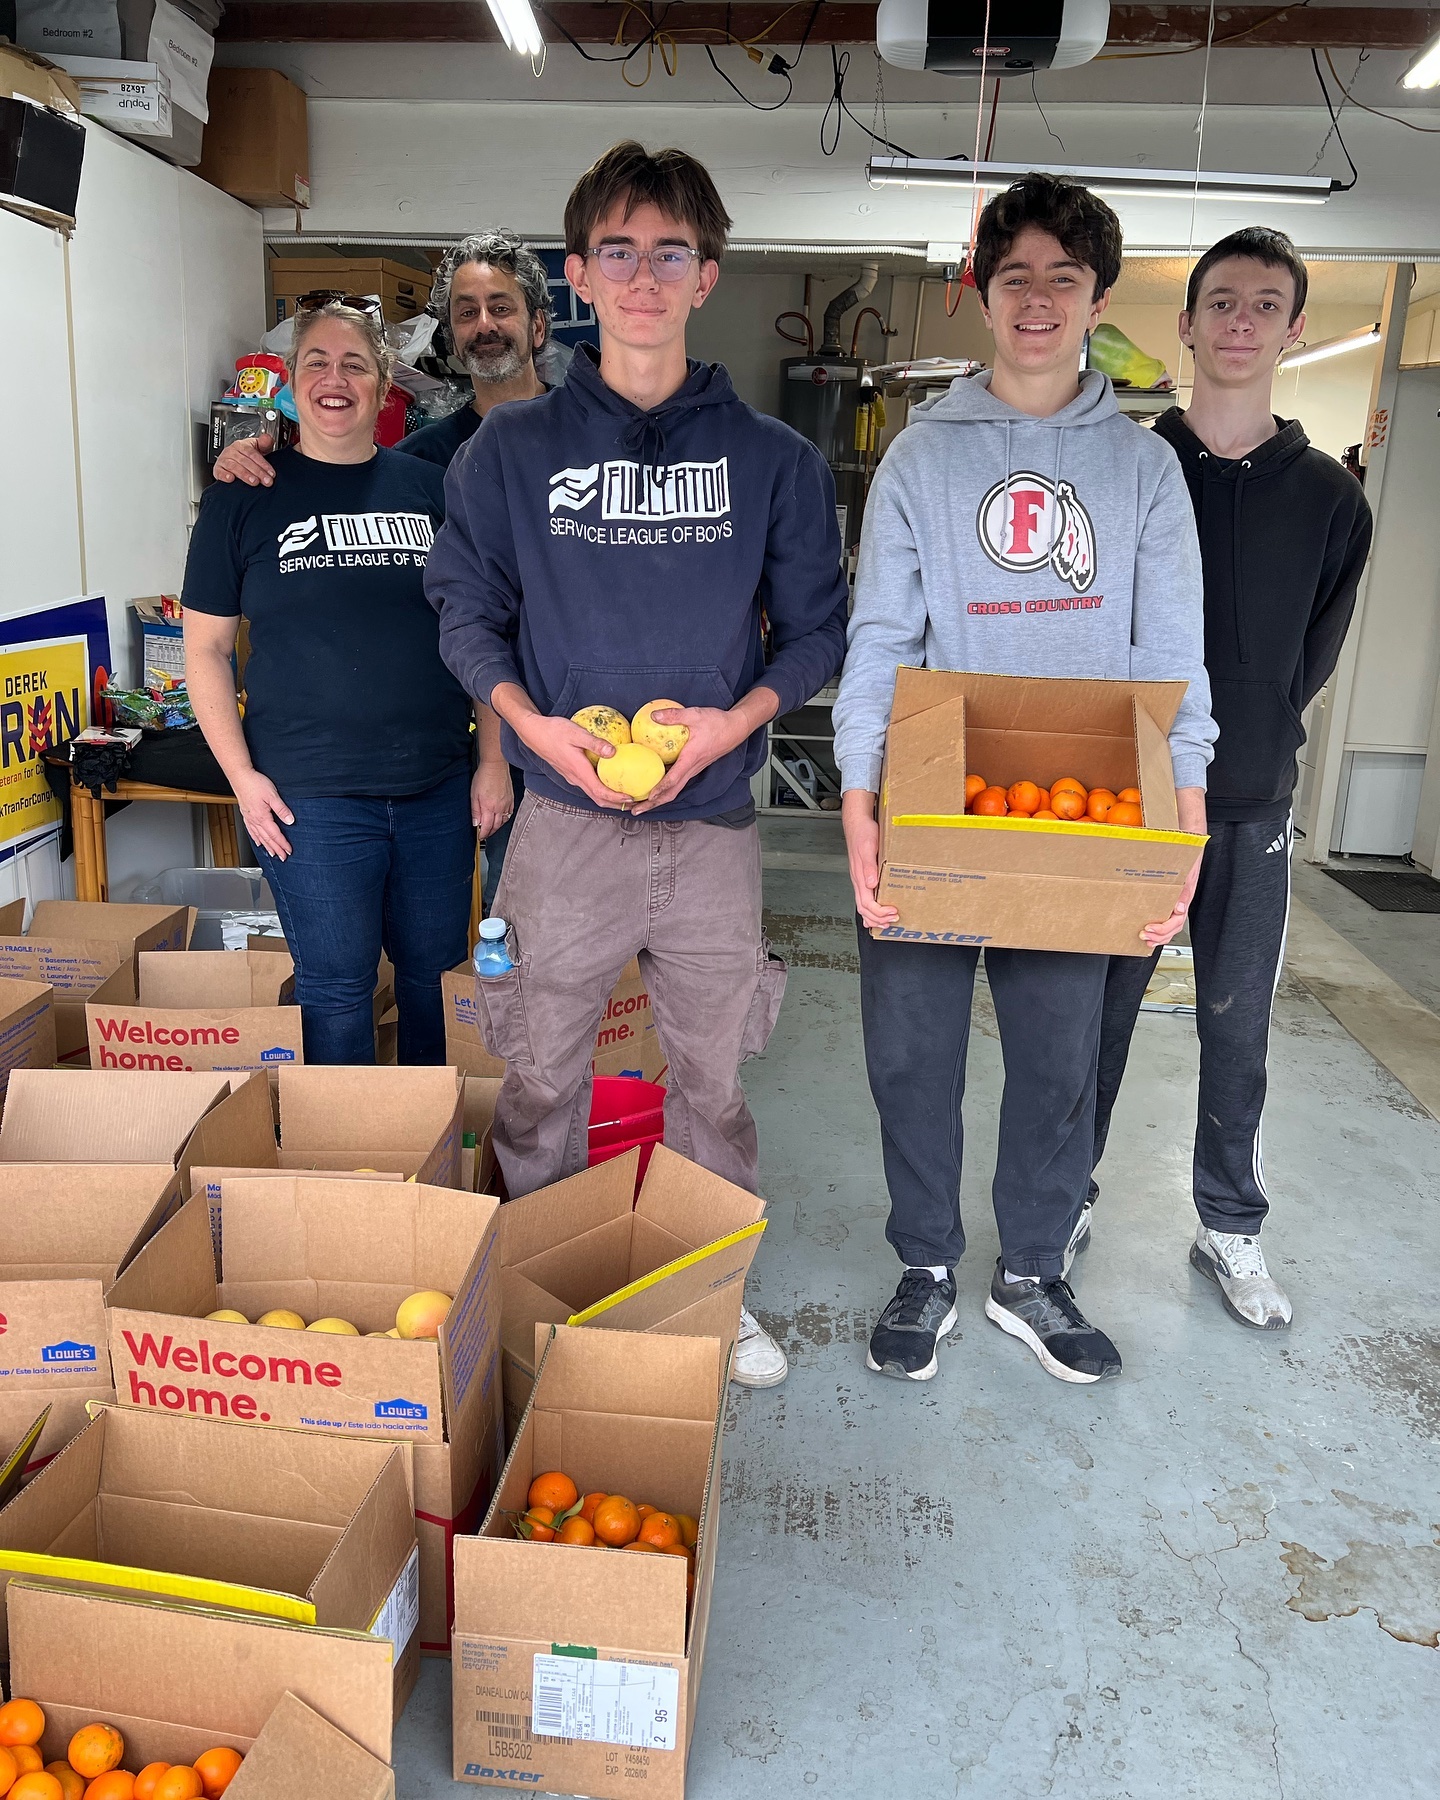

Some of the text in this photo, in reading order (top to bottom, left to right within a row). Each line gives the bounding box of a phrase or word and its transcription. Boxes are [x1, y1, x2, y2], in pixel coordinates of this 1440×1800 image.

[42, 27, 94, 39] Bedroom #2
[168, 39, 198, 67] Bedroom #2
[120, 83, 146, 94] 16x28
[118, 99, 150, 111] PopUP
[606, 462, 727, 516] FULLERTON
[328, 516, 434, 548] FULLERTON
[550, 517, 733, 545] SERVICE LEAGUE OF BOYS
[1006, 490, 1045, 554] F
[279, 552, 428, 574] SERVICE LEAGUE OF BO
[967, 595, 1104, 615] CROSS COUNTRY
[5, 670, 48, 698] DEREK
[0, 687, 80, 768] RAN
[0, 763, 45, 788] eteran for Co
[879, 926, 993, 944] Baxter
[46, 973, 74, 981] Laundry
[454, 994, 471, 1008] Let
[601, 993, 651, 1022] lcom
[95, 1017, 241, 1046] Welcome
[597, 1023, 635, 1048] me.
[99, 1045, 193, 1071] home.
[264, 1052, 292, 1060] LOWE'S
[47, 1348, 90, 1360] LOWE'S
[121, 1330, 342, 1388] Welcome
[50, 1366, 72, 1374] hacia
[73, 1365, 97, 1373] arriba
[128, 1370, 271, 1422] home.
[381, 1405, 422, 1417] LOWE'S
[300, 1417, 316, 1426] This
[316, 1419, 331, 1427] side
[348, 1421, 364, 1429] Este
[365, 1422, 381, 1430] lado
[382, 1423, 404, 1431] hacia
[405, 1423, 428, 1431] arriba
[462, 1641, 508, 1652] Recommended
[461, 1656, 499, 1666] temperature
[475, 1685, 504, 1699] DIANEAL
[504, 1689, 519, 1700] LOW
[654, 1709, 668, 1723] 95
[488, 1740, 533, 1761] L5B5202
[605, 1752, 619, 1762] LOT
[463, 1763, 545, 1783] Baxter
[605, 1765, 648, 1780] EXP 2026/08
